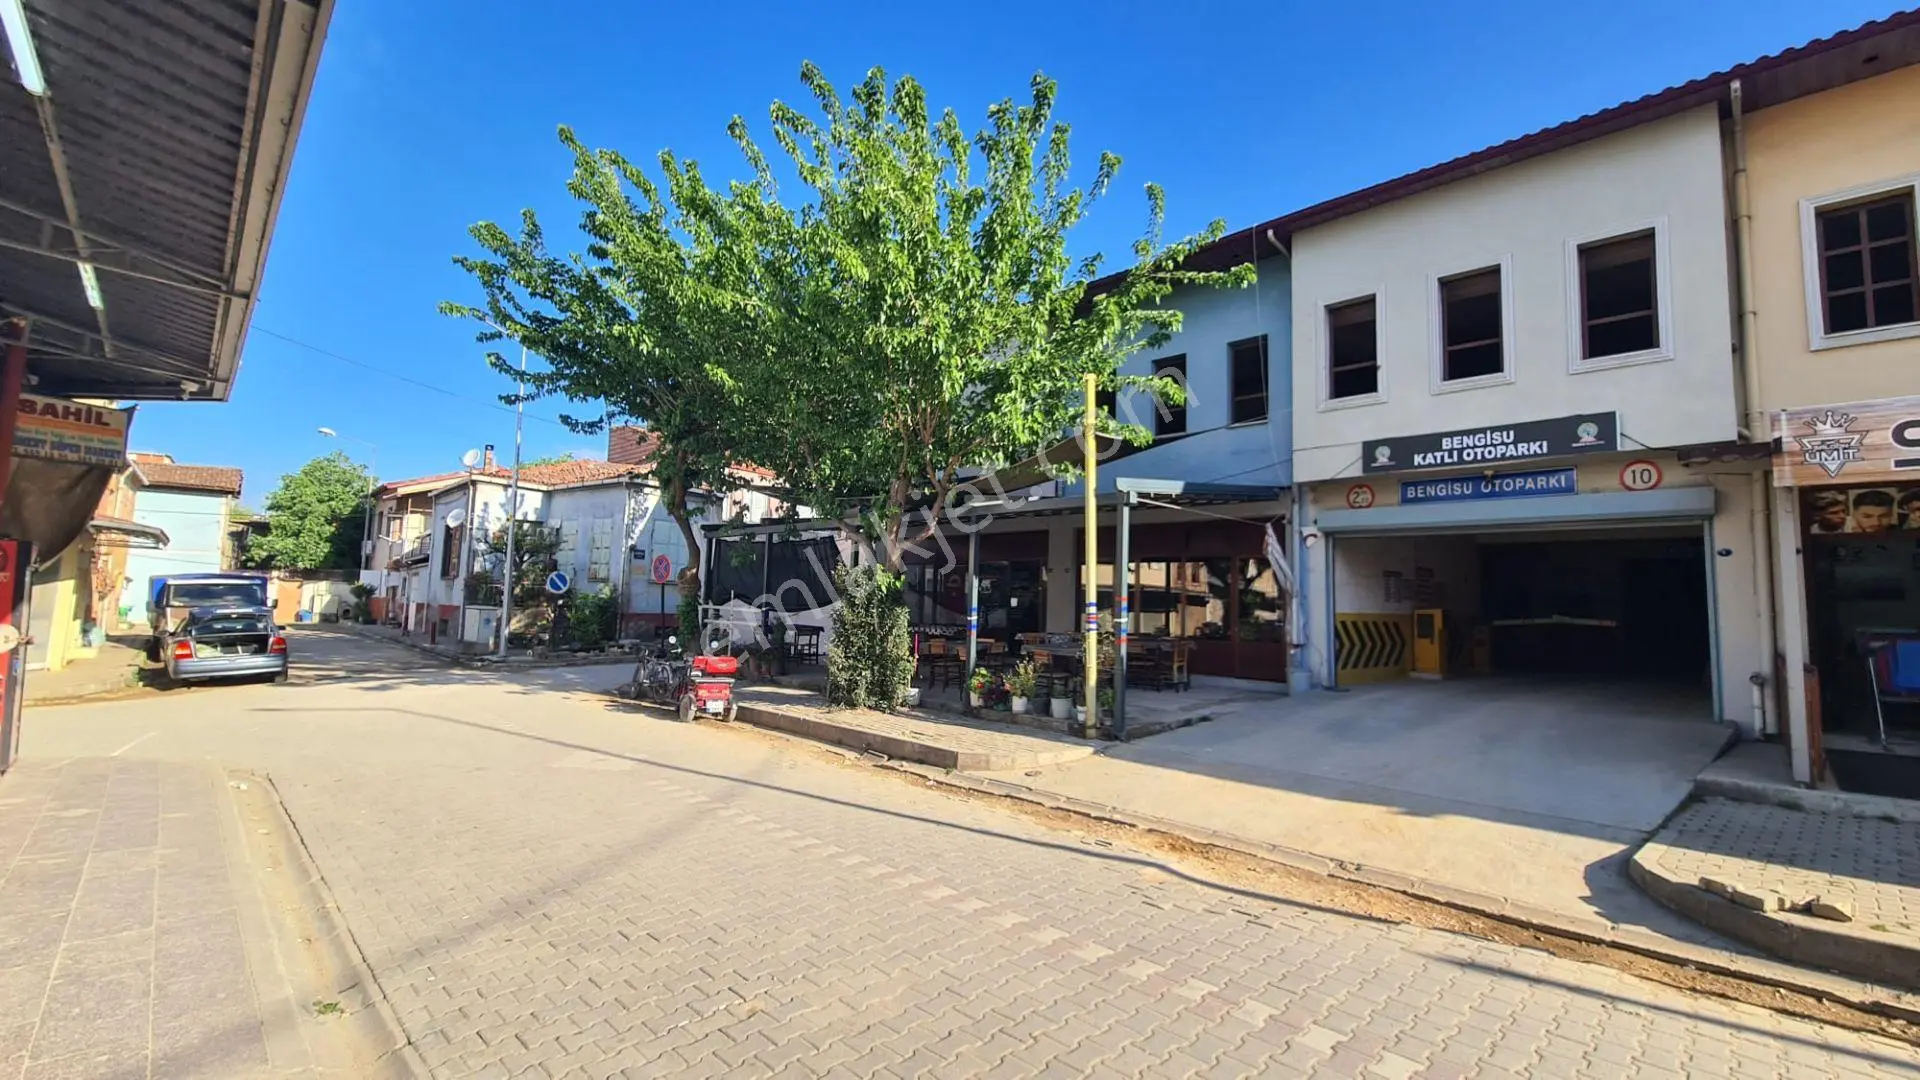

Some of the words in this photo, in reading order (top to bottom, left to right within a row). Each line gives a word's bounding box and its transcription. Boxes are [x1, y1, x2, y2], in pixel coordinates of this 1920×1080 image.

[1441, 430, 1515, 450] BENGİSU
[1413, 450, 1459, 466] KATLI
[1462, 440, 1548, 461] OTOPARKI
[1406, 480, 1473, 498] BENGİSU
[1481, 474, 1566, 493] OTOPARKI
[1631, 468, 1652, 484] 10
